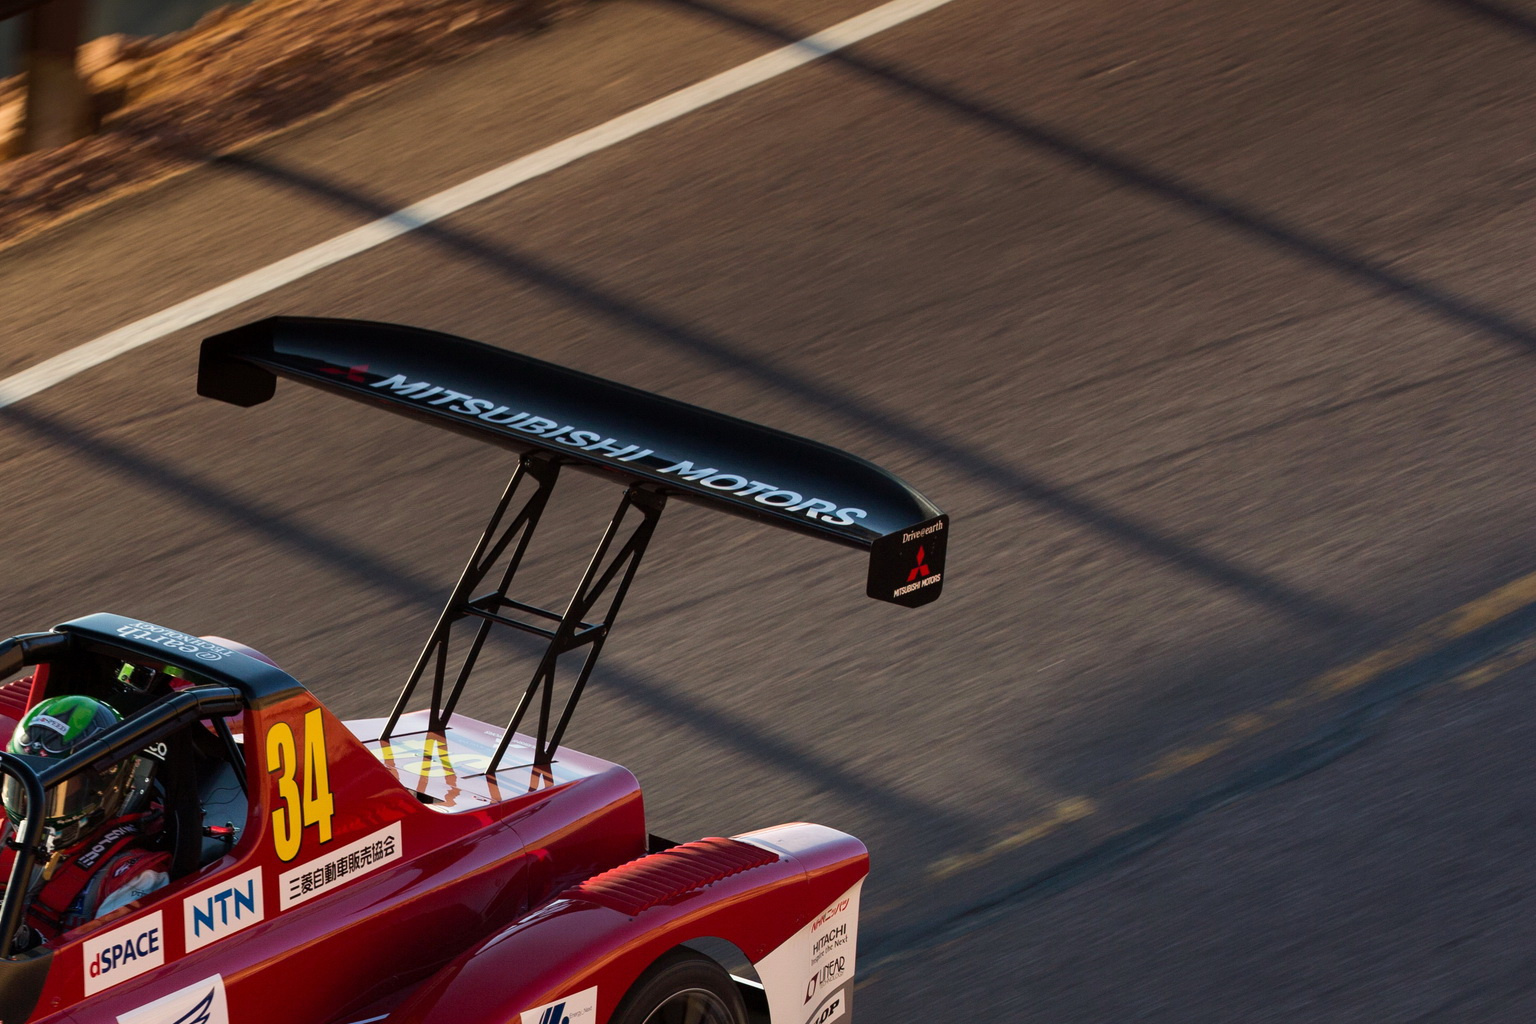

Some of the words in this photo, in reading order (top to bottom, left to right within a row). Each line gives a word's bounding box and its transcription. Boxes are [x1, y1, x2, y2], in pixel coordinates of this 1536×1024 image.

[369, 373, 654, 462] MITSUBISHI
[656, 460, 868, 526] MOTORS
[902, 520, 944, 544] Drive@earth
[893, 580, 921, 598] MITSUBISHI
[921, 573, 941, 588] MOTORS
[266, 706, 335, 863] 34
[289, 835, 395, 901] 三菱自動車販売協会
[193, 878, 255, 938] NTN
[89, 927, 159, 978] dSPACE
[812, 923, 847, 956] HITACHI
[834, 934, 849, 948] Next
